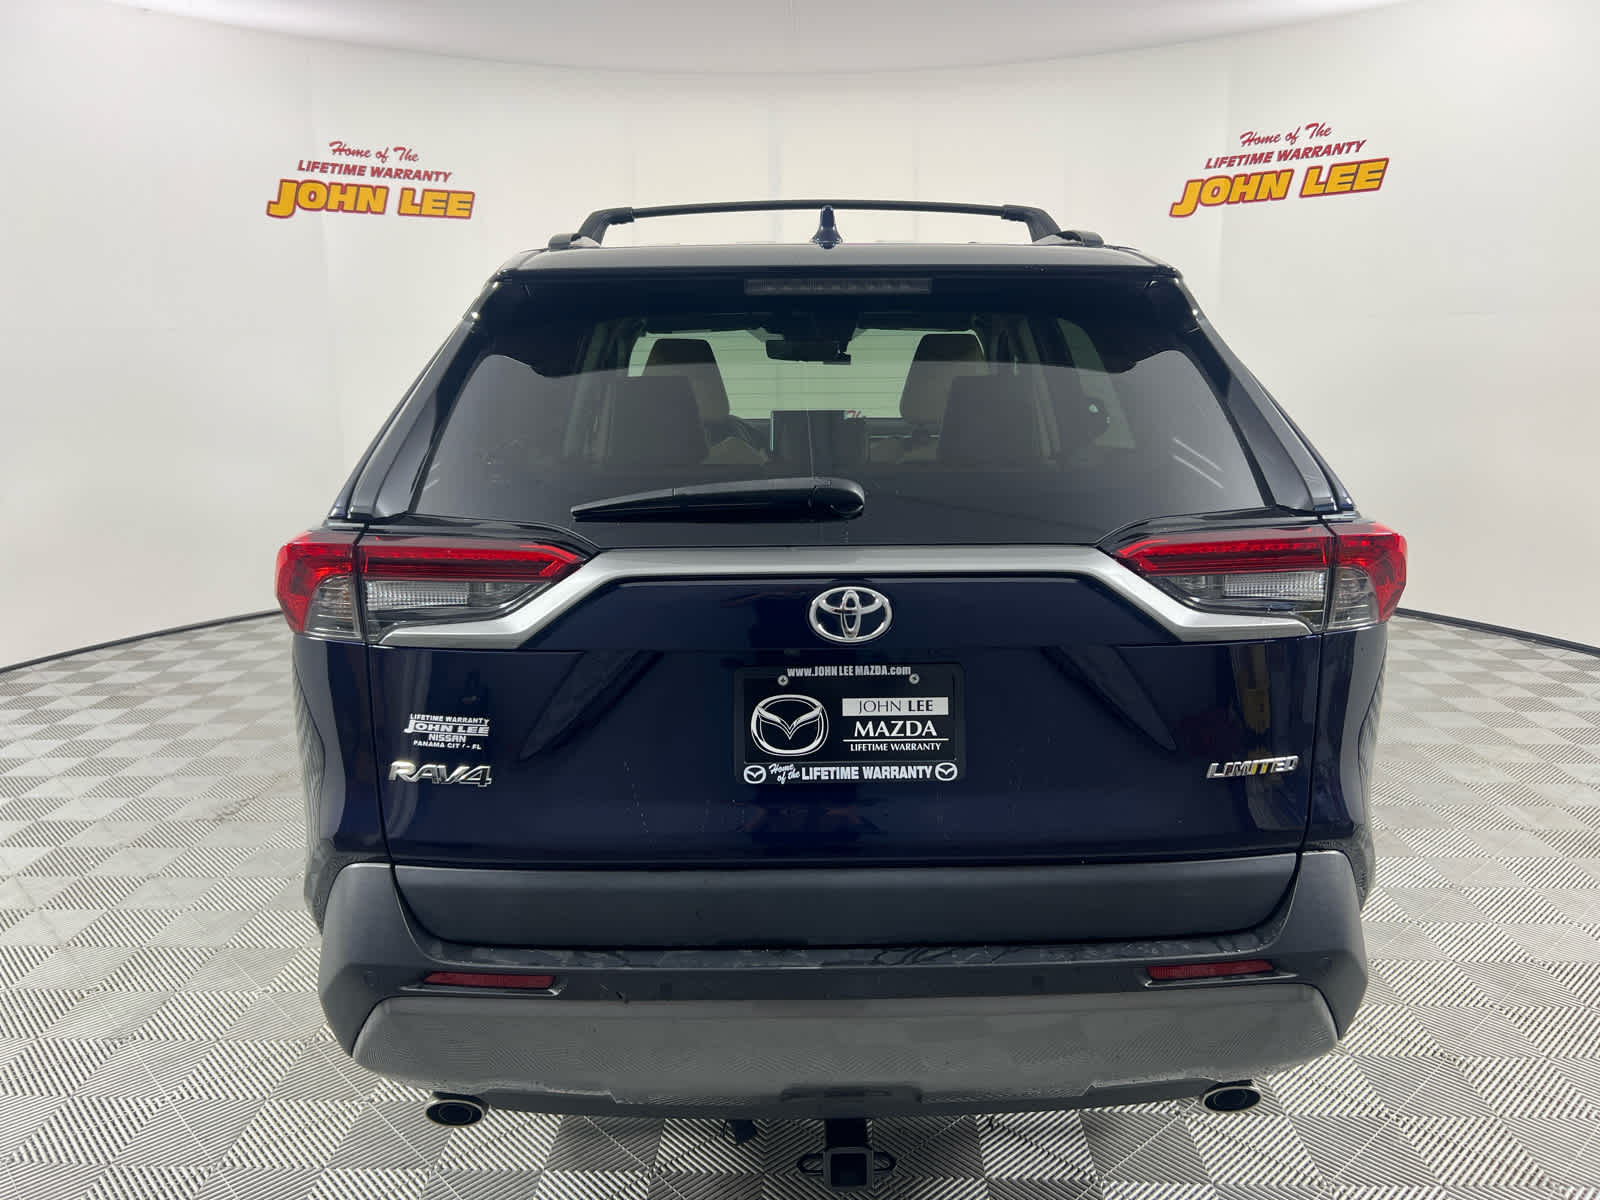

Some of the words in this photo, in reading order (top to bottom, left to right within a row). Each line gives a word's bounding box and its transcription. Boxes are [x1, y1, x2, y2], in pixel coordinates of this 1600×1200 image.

[1239, 131, 1281, 147] Home
[1285, 126, 1301, 144] of
[1305, 122, 1332, 140] The
[329, 140, 371, 159] Home
[375, 149, 389, 164] of
[393, 146, 420, 162] The
[1204, 151, 1273, 169] LIFETIME
[1276, 139, 1367, 162] WARRANTY
[297, 159, 366, 177] LIFETIME
[370, 166, 452, 183] WARRANTY
[1169, 168, 1295, 218] JOHN
[1299, 157, 1389, 199] LEE
[266, 178, 389, 219] JOHN
[397, 187, 475, 220] LEE
[839, 665, 854, 676] LEE
[858, 700, 902, 714] JOHN
[907, 699, 934, 712] LEE
[403, 719, 454, 734] JOHN
[457, 725, 490, 734] LEE
[410, 713, 444, 722] LIFETIME
[445, 716, 490, 726] WARRANTY
[854, 720, 938, 737] MAZDA
[413, 739, 446, 748] PANAMA
[428, 733, 467, 743] NISSAN
[850, 743, 889, 752] LIFETIME
[891, 742, 942, 751] WARRANTY
[388, 760, 492, 787] RAV4
[768, 763, 795, 774] Home
[801, 766, 860, 780] LIFETIME
[862, 765, 933, 780] WARRANTY
[1206, 755, 1299, 779] LIMITED
[777, 772, 786, 785] of
